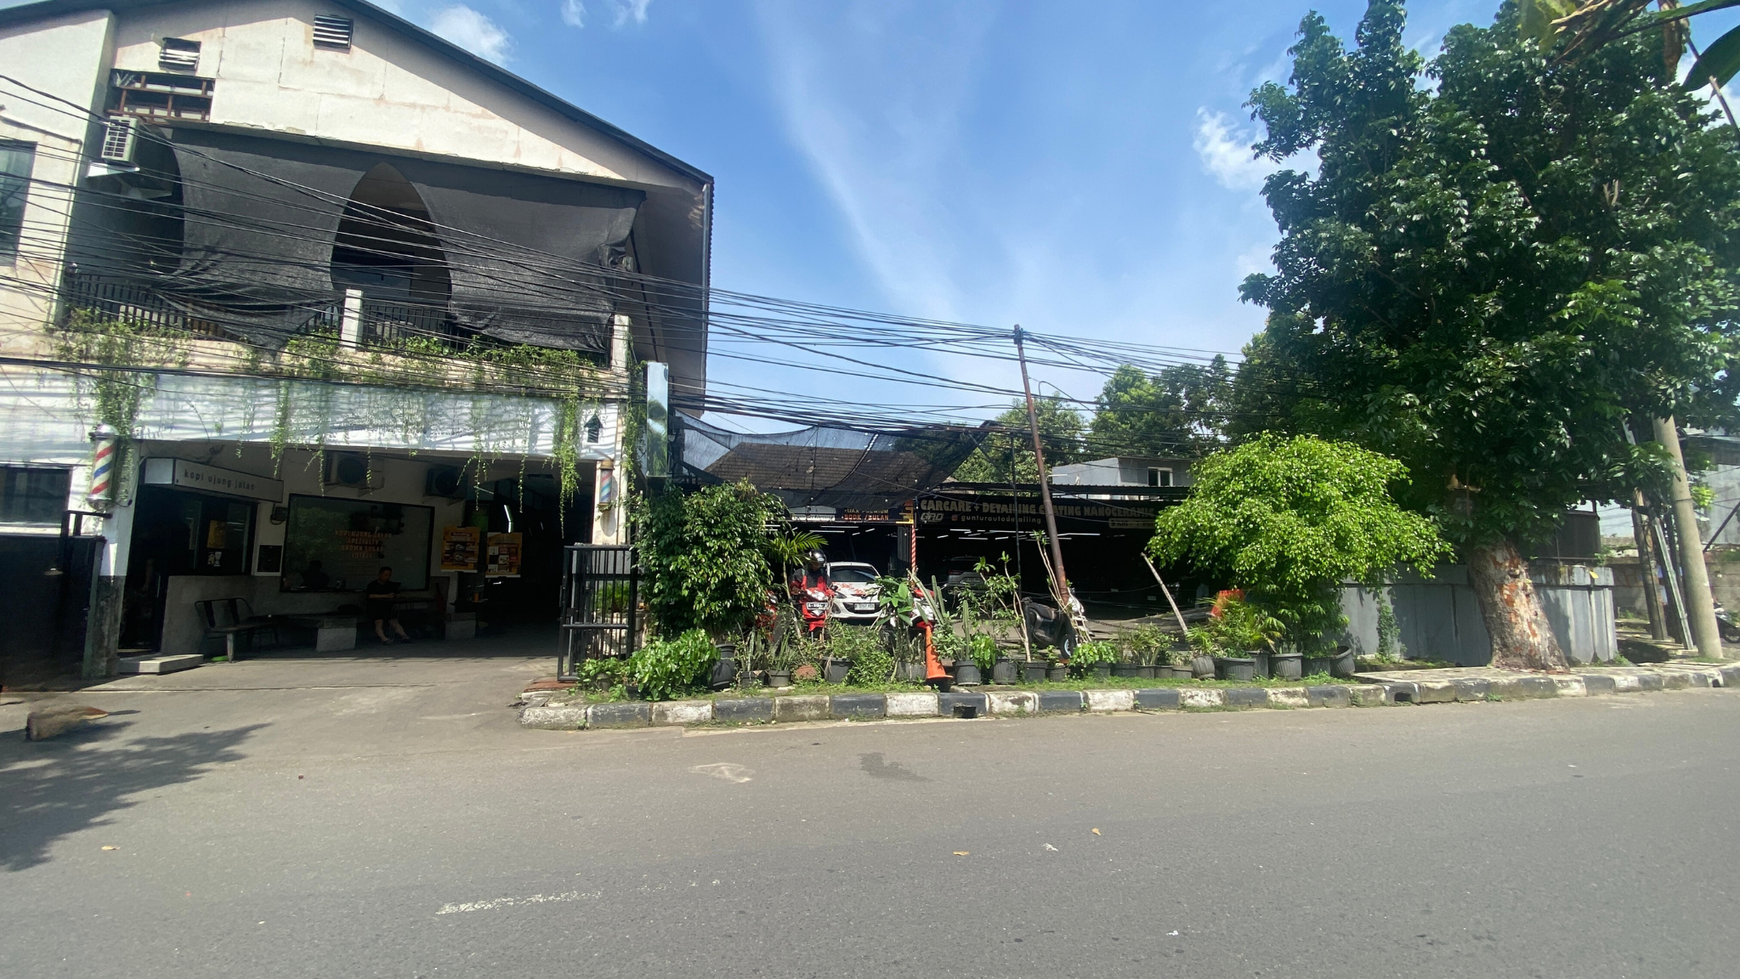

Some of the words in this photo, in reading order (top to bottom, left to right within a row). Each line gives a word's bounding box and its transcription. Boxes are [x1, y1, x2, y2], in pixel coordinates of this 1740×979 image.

[184, 469, 204, 481] kopi
[208, 475, 232, 488] ujung
[234, 479, 255, 491] jalan
[920, 499, 972, 512] CARCARE
[1038, 504, 1082, 517] CATING
[961, 514, 1042, 524] gunturautodeailing
